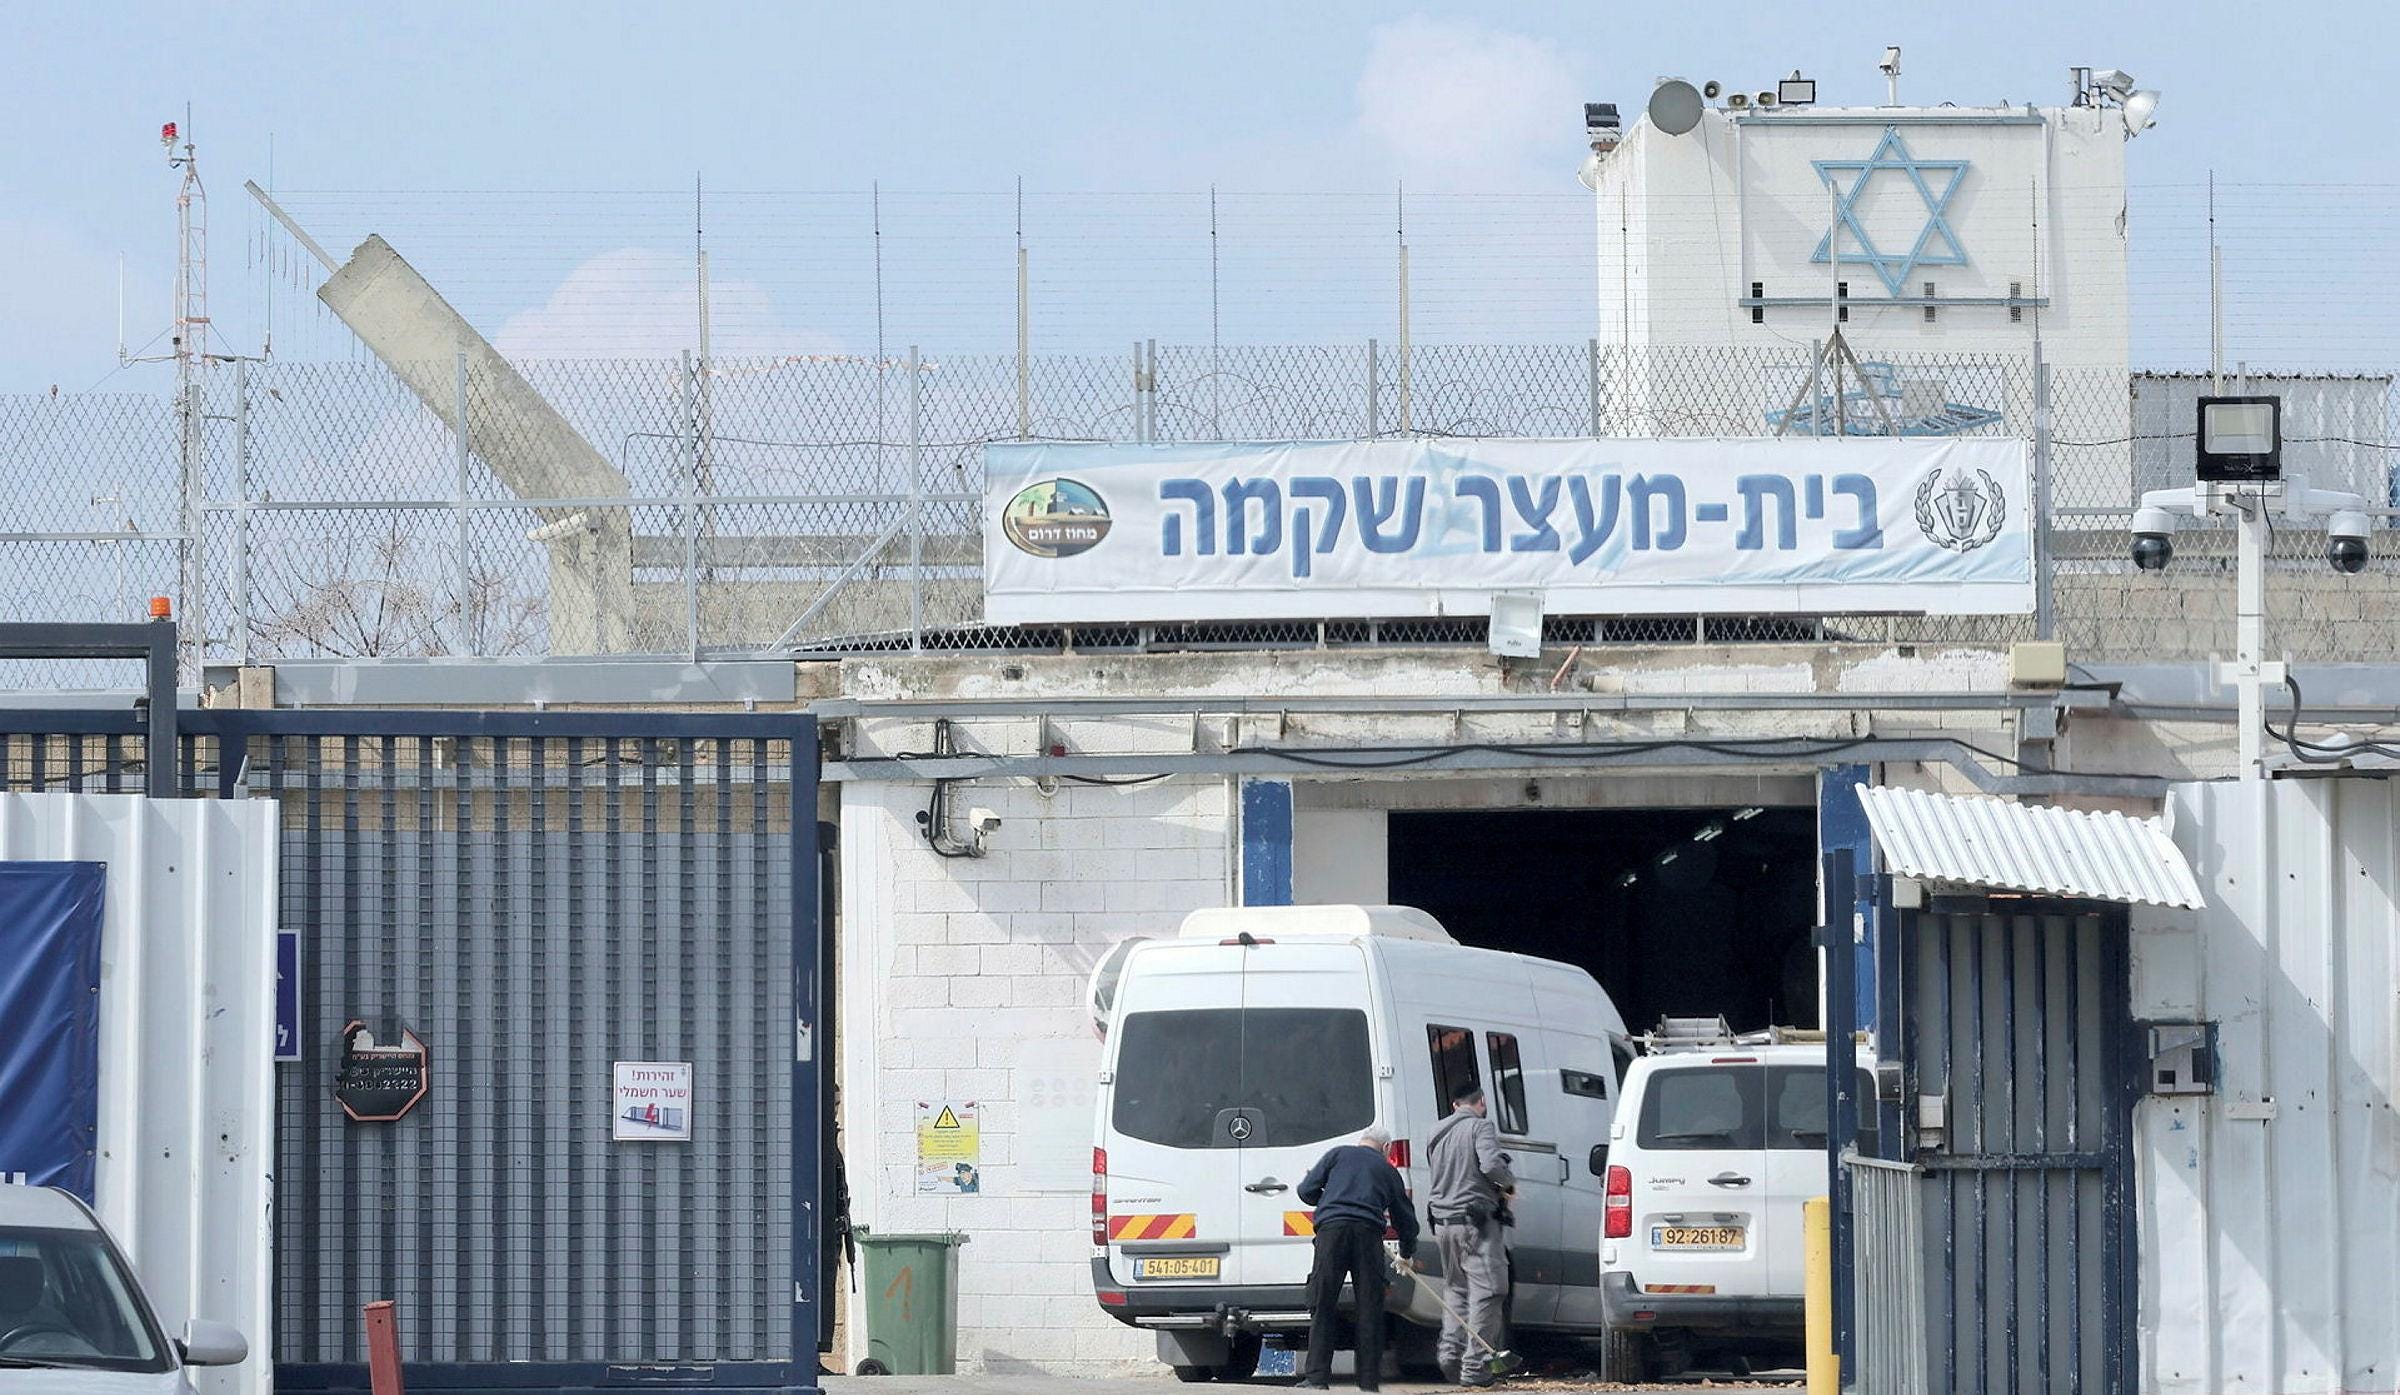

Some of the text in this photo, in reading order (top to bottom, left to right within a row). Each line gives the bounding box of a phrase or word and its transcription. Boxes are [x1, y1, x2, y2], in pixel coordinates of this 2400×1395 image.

[1160, 472, 1884, 577] בית-מעצר שקמה
[1028, 528, 1098, 540] מחוז דרום
[632, 1069, 675, 1081] זהירות!
[619, 1085, 687, 1098] שער חשמלי
